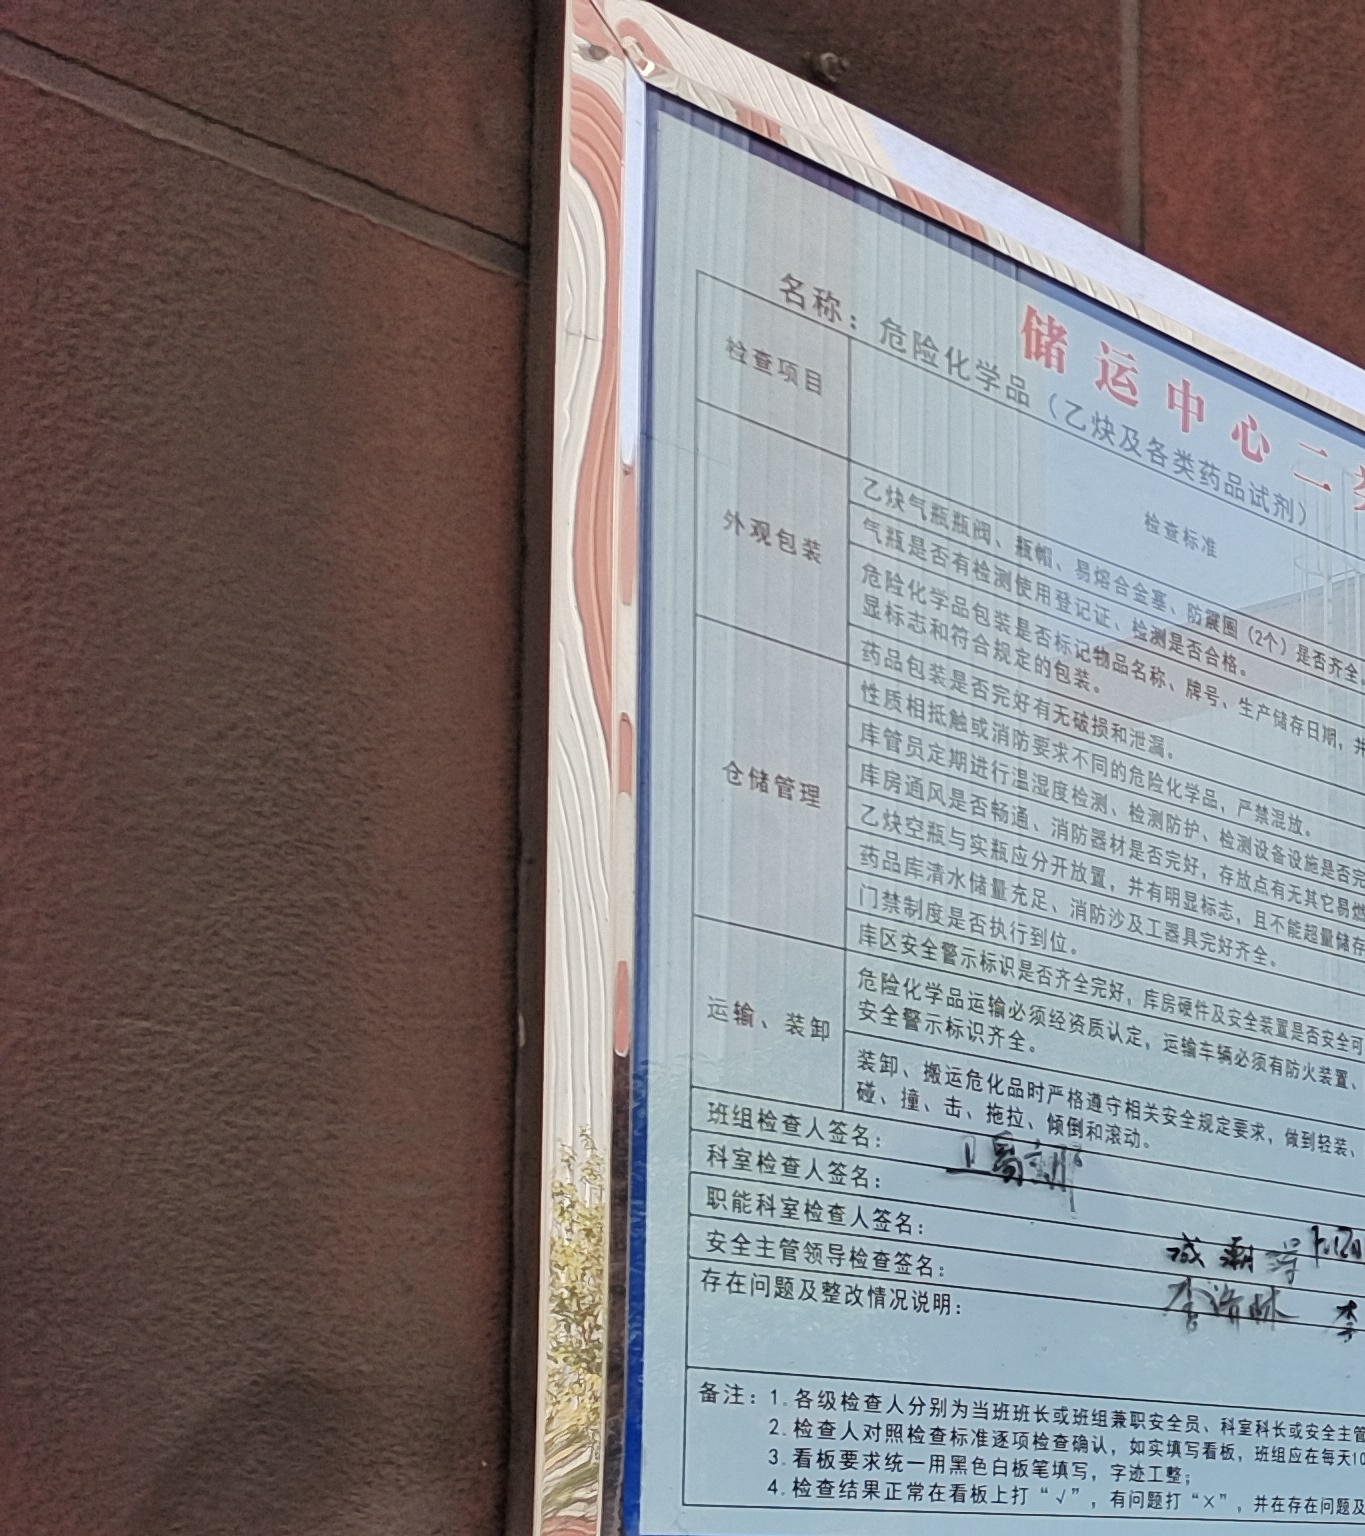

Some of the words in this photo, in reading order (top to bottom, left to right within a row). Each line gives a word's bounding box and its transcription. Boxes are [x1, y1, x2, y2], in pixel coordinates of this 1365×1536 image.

[725, 335, 823, 396] 检查项目
[723, 508, 822, 565] 外观包装
[1144, 511, 1218, 559] 检查标准
[722, 760, 822, 809] 仓储管理
[706, 995, 831, 1041] 运输、装卸
